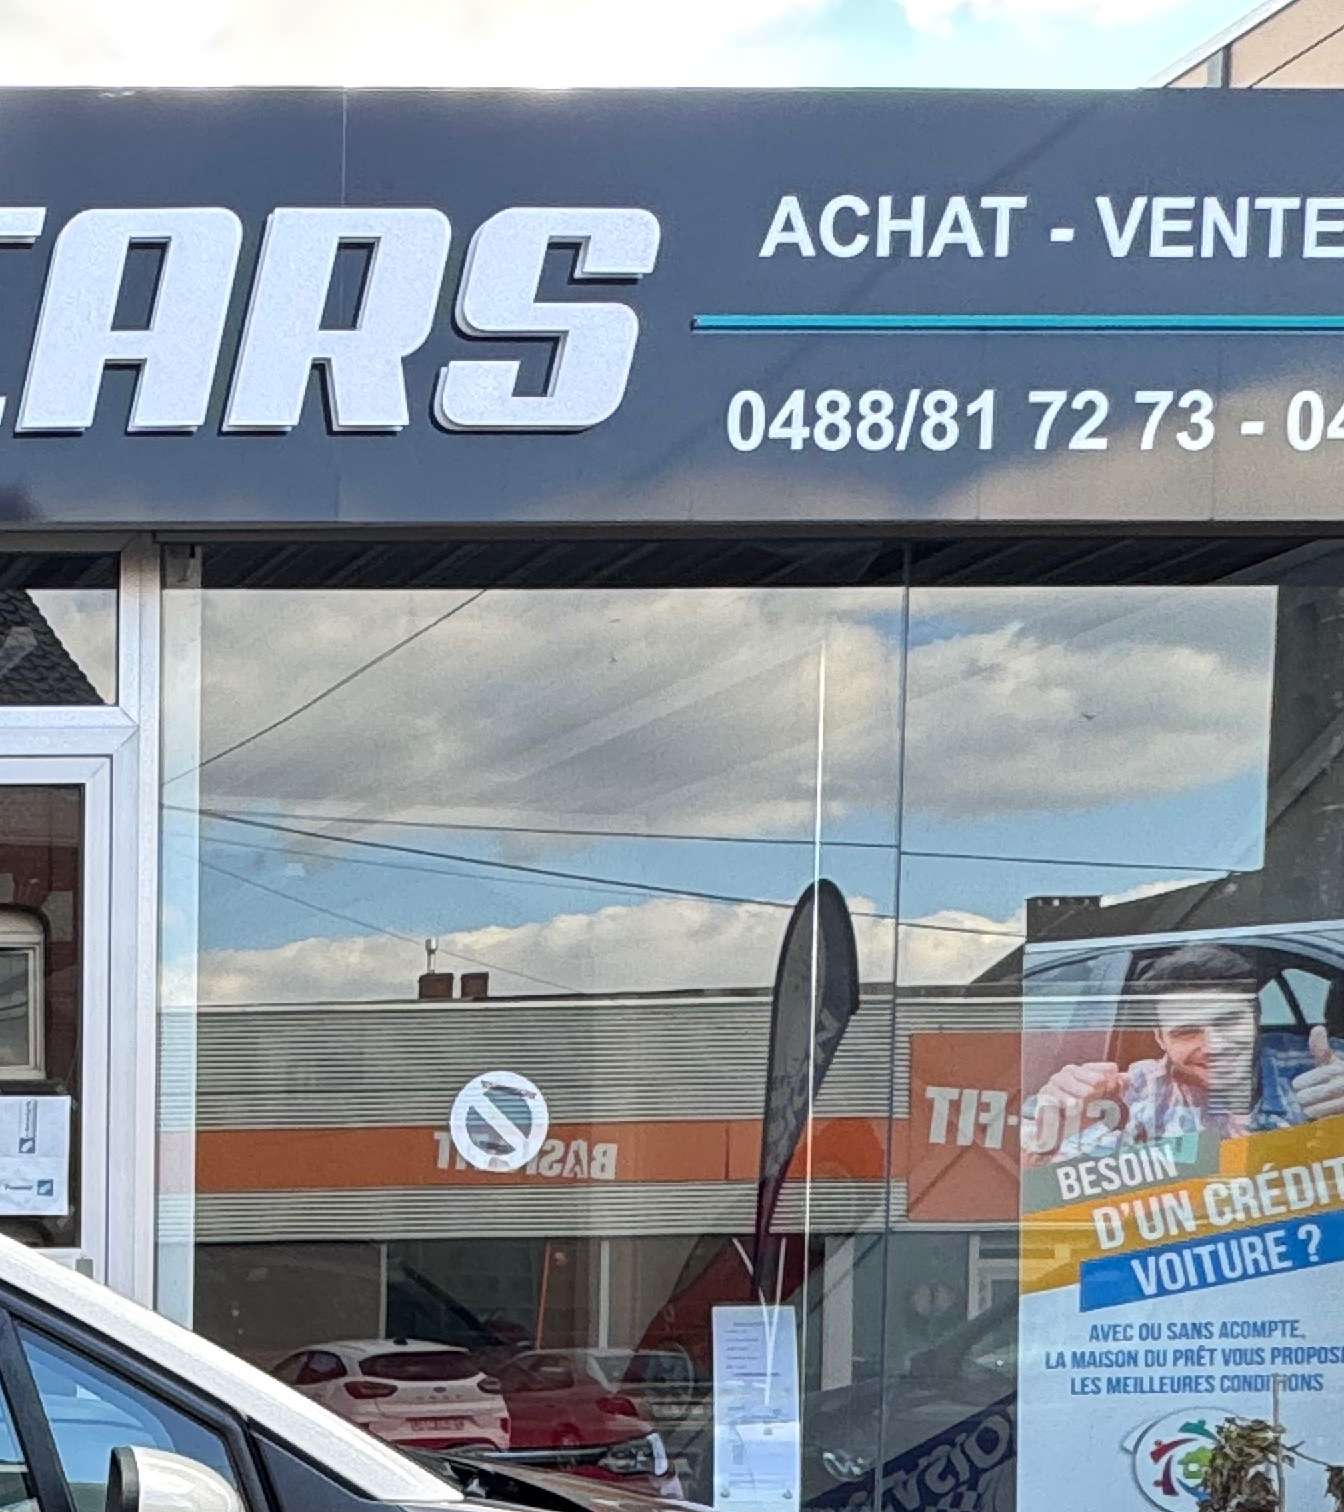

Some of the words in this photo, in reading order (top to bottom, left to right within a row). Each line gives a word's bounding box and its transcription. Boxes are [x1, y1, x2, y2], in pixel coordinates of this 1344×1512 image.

[759, 195, 1028, 258] ACHAT
[1050, 228, 1075, 243] -
[1096, 196, 1344, 259] VENTE
[726, 388, 995, 452] 0488/81
[1028, 389, 1109, 451] 72
[1134, 389, 1216, 452] 73
[1240, 419, 1265, 435] -
[1056, 1146, 1179, 1201] BESOIN
[1092, 1189, 1197, 1251] D'UN
[1202, 1156, 1344, 1228] CRÉDIT
[1131, 1232, 1292, 1297] VOITURE
[1297, 1224, 1323, 1262] ?
[1045, 1351, 1066, 1370] LA
[1071, 1349, 1139, 1369] MAISON
[1144, 1349, 1168, 1368] DU
[1172, 1345, 1218, 1367] PRÊT
[1221, 1346, 1266, 1366] VOUS
[1270, 1346, 1344, 1365] PROPOS
[1089, 1323, 1134, 1342] AVEC
[1138, 1322, 1162, 1341] OU
[1166, 1321, 1214, 1340] SANS
[1219, 1319, 1306, 1340] ACOMPTE,
[1070, 1376, 1102, 1395] LES
[1106, 1374, 1215, 1394] MEILLEURES
